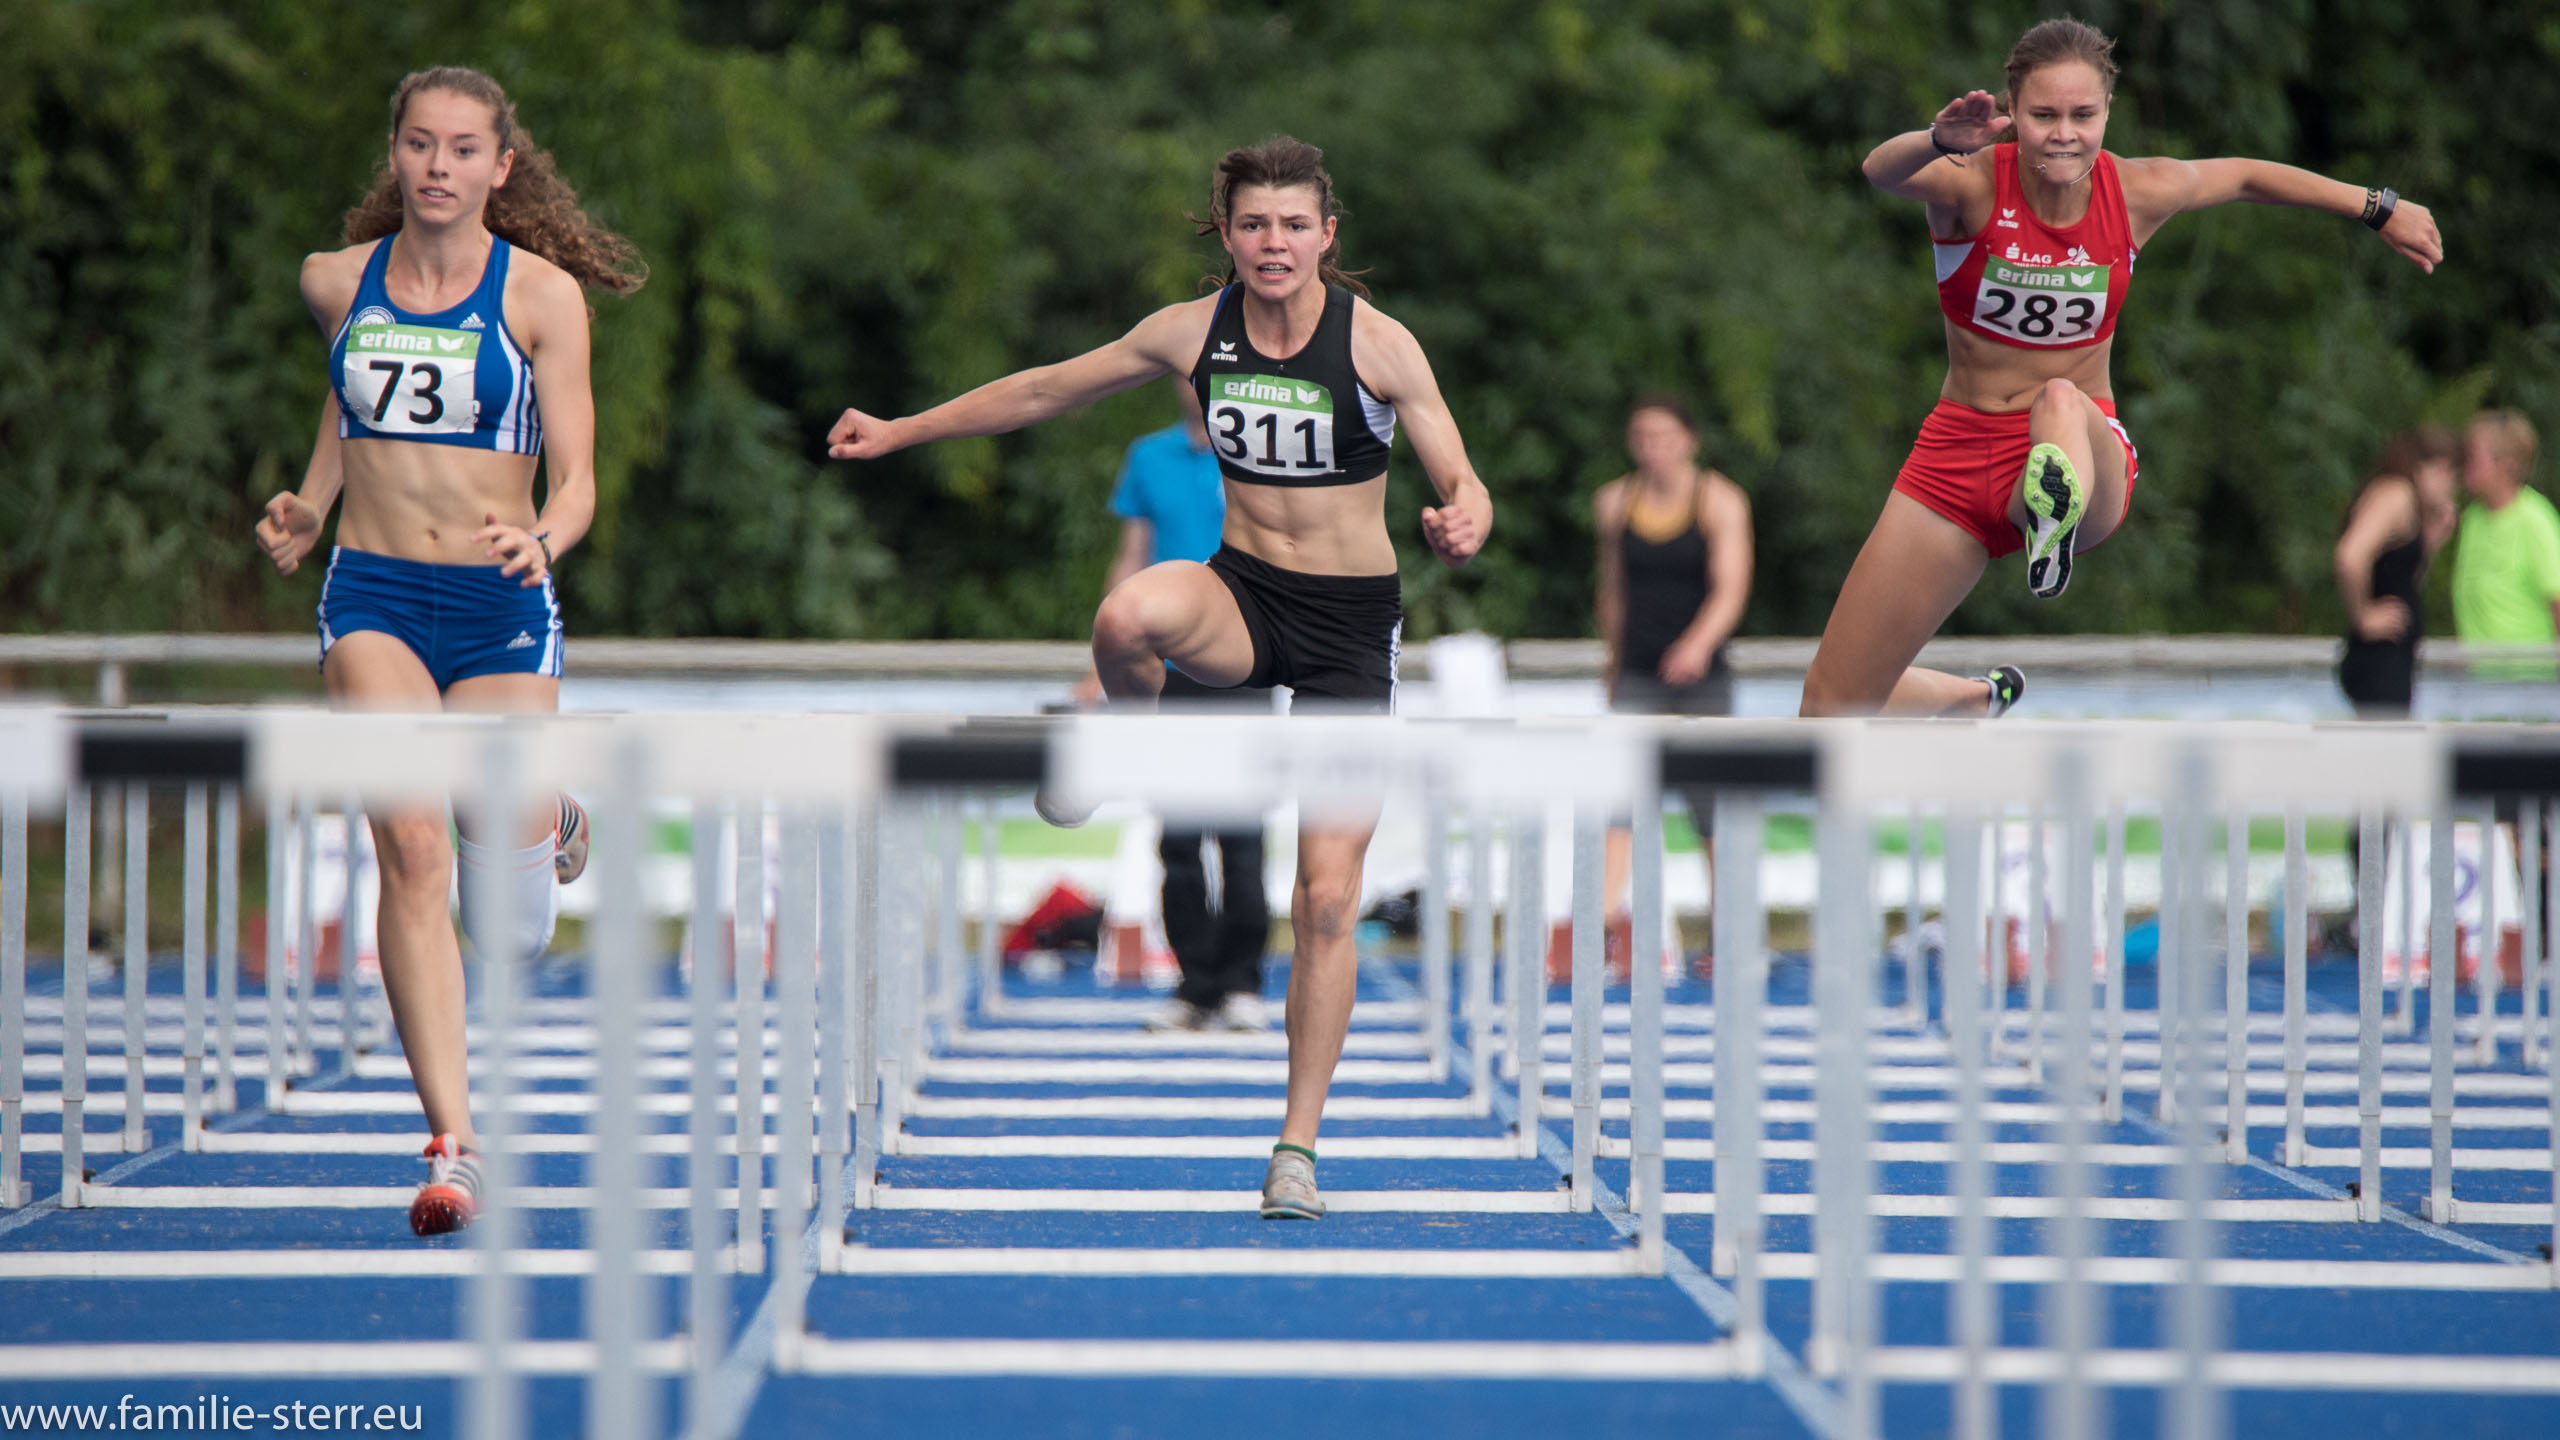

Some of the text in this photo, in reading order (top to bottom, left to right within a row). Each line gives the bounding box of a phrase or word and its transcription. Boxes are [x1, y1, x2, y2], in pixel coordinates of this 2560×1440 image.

[2022, 252, 2052, 264] LAG
[1996, 267, 2065, 287] erima
[1980, 288, 2096, 338] 283
[359, 330, 432, 351] erima
[1211, 352, 1238, 362] erima
[369, 359, 444, 424] 73
[1224, 379, 1292, 403] erima
[1216, 406, 1327, 469] 311
